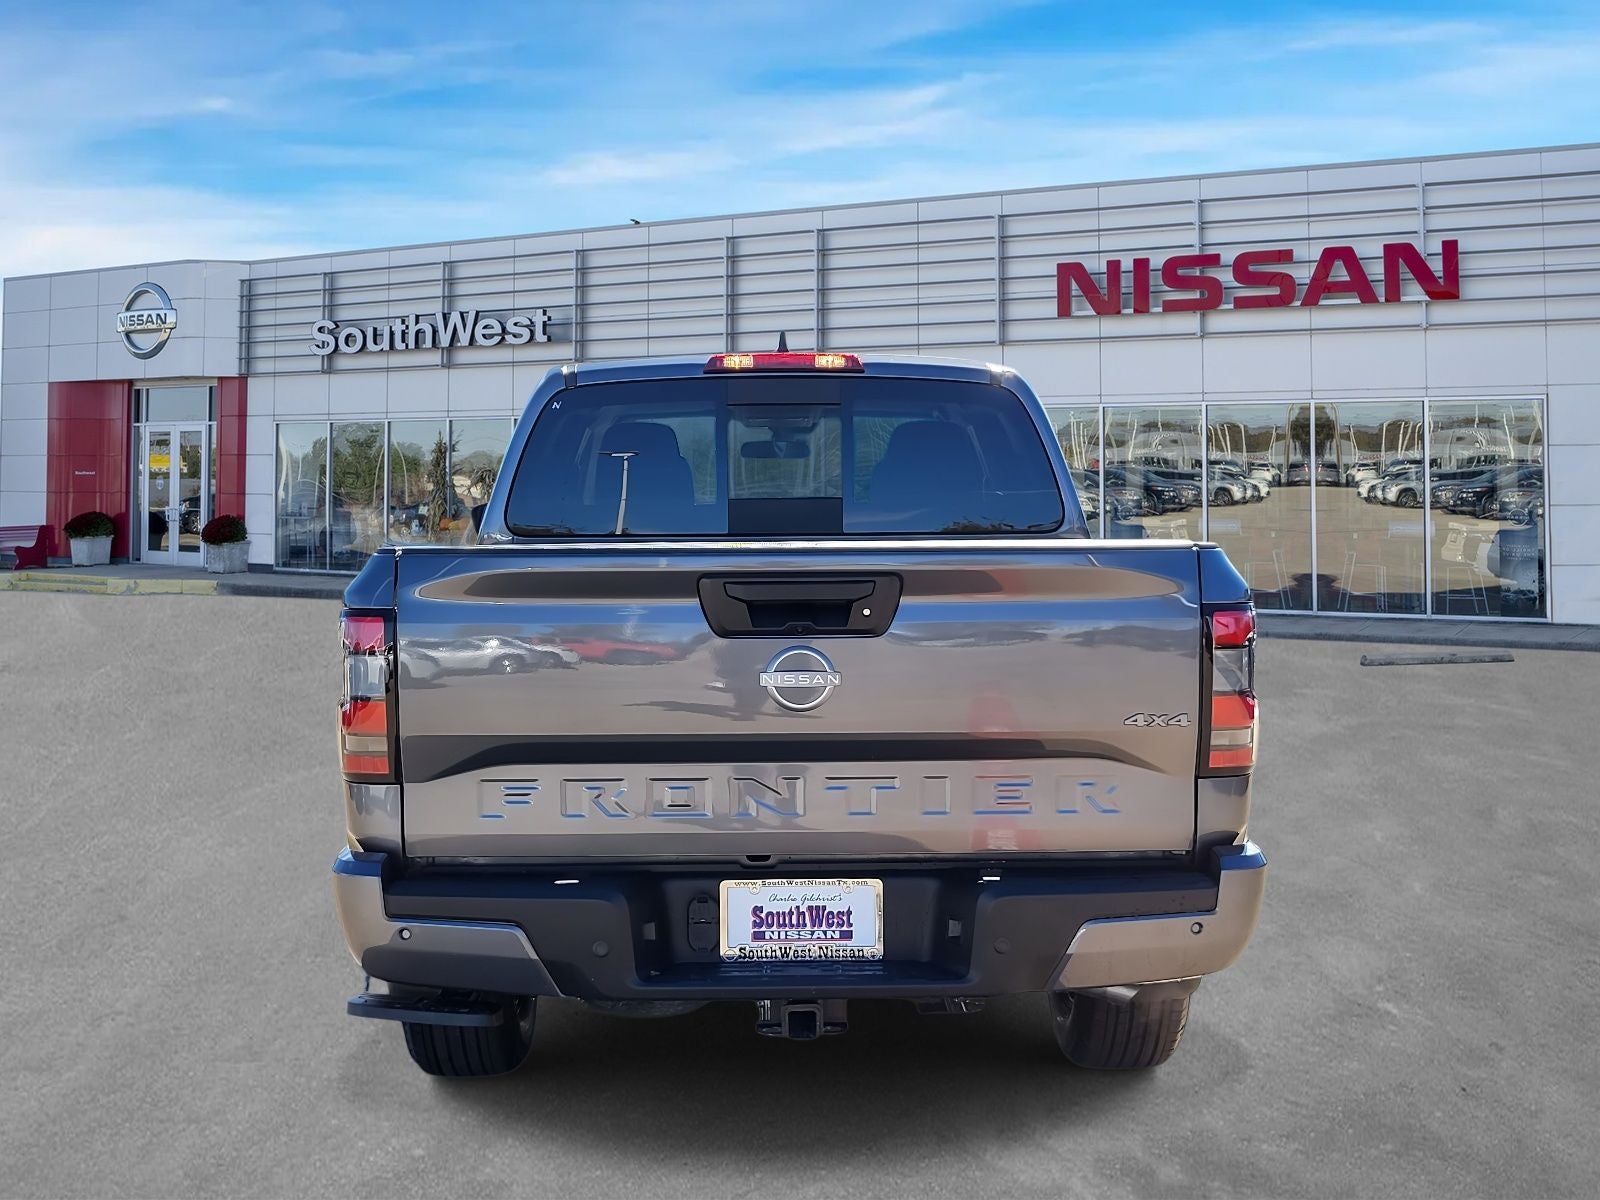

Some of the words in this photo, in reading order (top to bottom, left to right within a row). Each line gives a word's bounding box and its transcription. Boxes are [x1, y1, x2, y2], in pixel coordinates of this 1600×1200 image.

[1057, 239, 1461, 317] NISSAN
[119, 312, 168, 328] NISSAN
[309, 308, 551, 356] SouthWest
[761, 674, 840, 685] NISSAN
[478, 775, 1121, 819] FRONTIER
[768, 893, 798, 903] Charlie
[751, 904, 854, 930] SouthWest
[764, 930, 840, 940] NISSAN
[738, 946, 813, 961] SouthWest
[817, 946, 866, 961] Nissan
